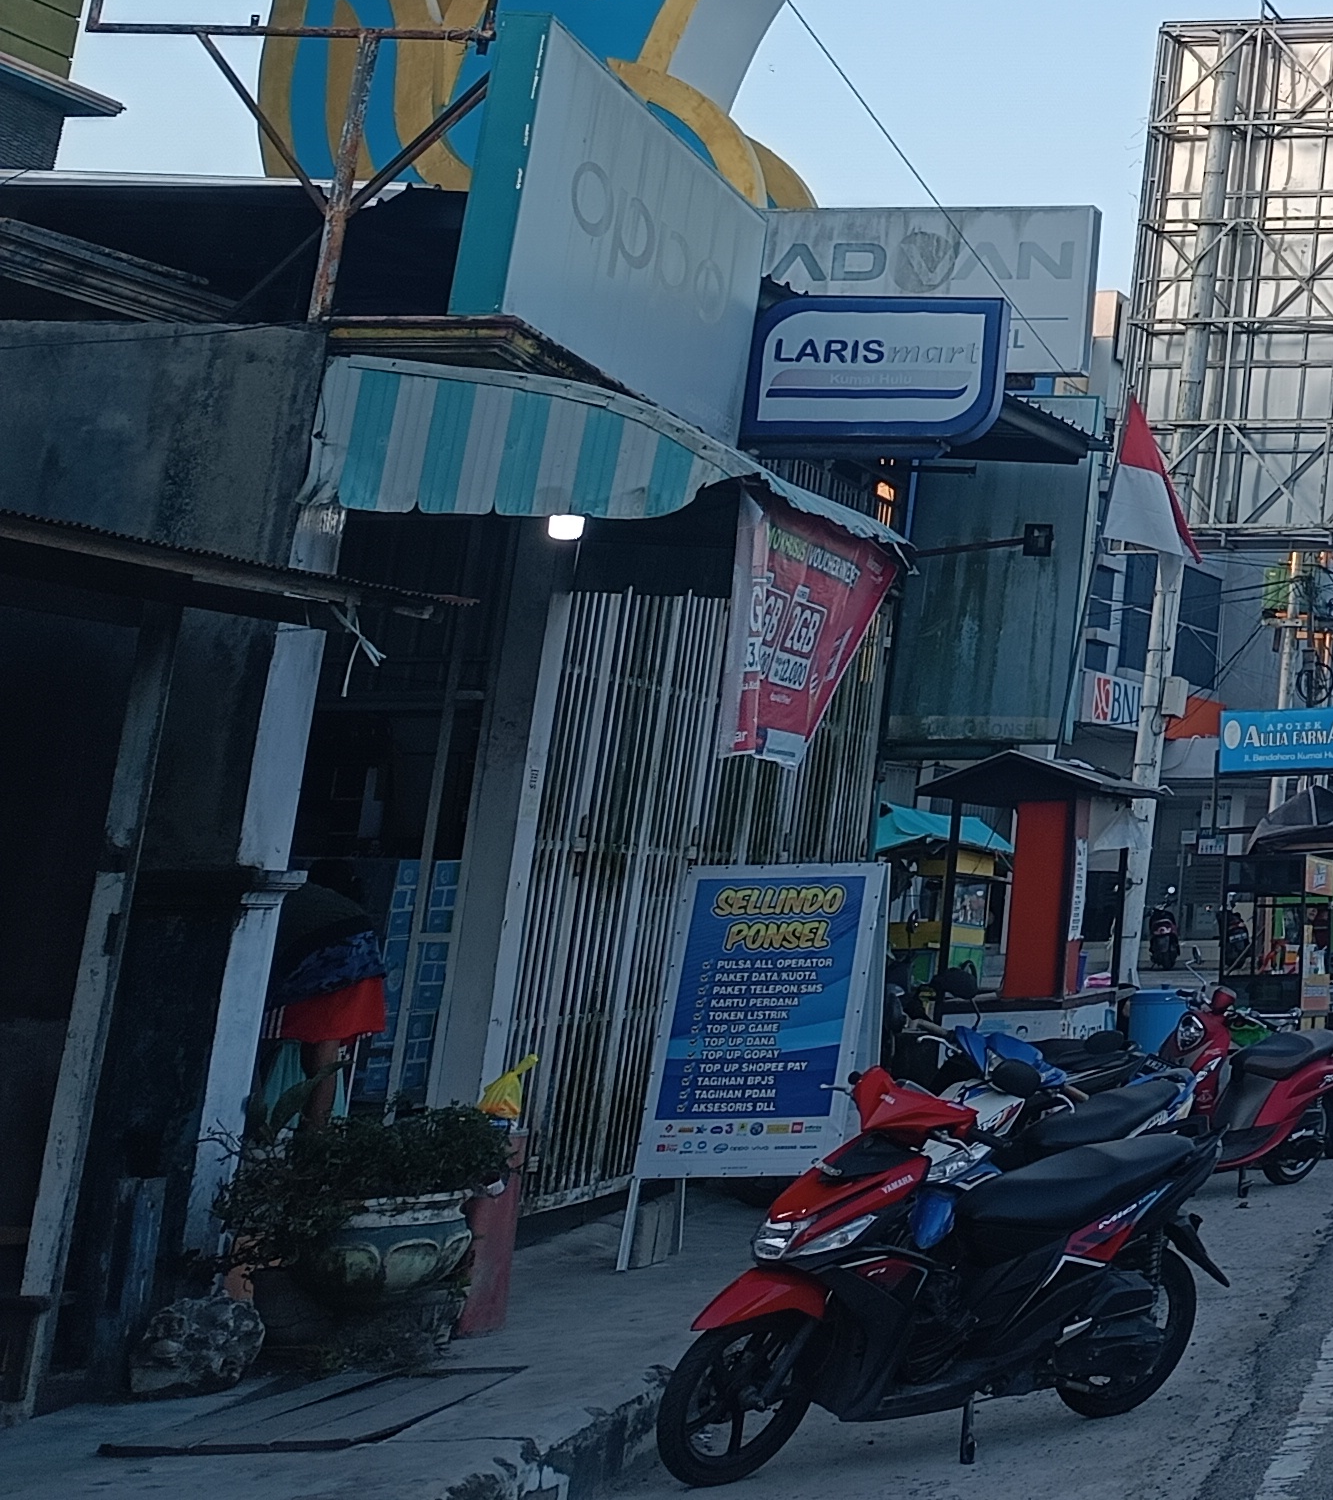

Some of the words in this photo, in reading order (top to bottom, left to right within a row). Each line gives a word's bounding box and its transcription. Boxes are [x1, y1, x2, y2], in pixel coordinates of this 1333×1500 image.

[770, 232, 1075, 293] ADVAN
[829, 372, 876, 386] Kumai
[879, 373, 913, 386] Hulu
[784, 605, 821, 654] 2GB
[1110, 681, 1143, 727] BNI
[1266, 721, 1322, 732] APOTEK
[1243, 725, 1289, 748] AULIA
[1252, 752, 1296, 762] Bendahara
[1297, 751, 1323, 761] Kumai
[712, 884, 845, 917] SELLINDO
[724, 919, 830, 951] PONSEL
[717, 959, 751, 969] PULSA
[754, 959, 773, 969] ALL
[776, 957, 834, 968] OPERATOR
[714, 972, 749, 982] PAKET
[712, 985, 748, 996] PAKET
[710, 998, 747, 1008] KARTU
[748, 997, 799, 1008] PERDANA
[708, 1011, 745, 1021] TOKEN
[747, 1010, 789, 1020] LISTRIK
[706, 1025, 729, 1035] TOP
[730, 1024, 747, 1034] UP
[748, 1024, 780, 1034] GAME
[704, 1038, 726, 1048] TOP
[728, 1037, 744, 1047] UP
[746, 1037, 776, 1047] DANA
[702, 1051, 724, 1061] TOP
[726, 1050, 742, 1060] UP
[743, 1050, 781, 1060] GOPAY
[699, 1064, 722, 1074] TOP
[723, 1063, 740, 1073] UP
[741, 1063, 785, 1073] SHOPEE
[787, 1063, 809, 1073] PAY
[697, 1077, 745, 1087] TAGIHAN
[747, 1076, 775, 1086] BPJS
[694, 1090, 742, 1100] TAGIHAN
[744, 1089, 777, 1099] PDAM
[691, 1103, 754, 1113] AKSESORIS
[755, 1102, 776, 1112] DLL
[881, 1174, 915, 1195] YAMAHA
